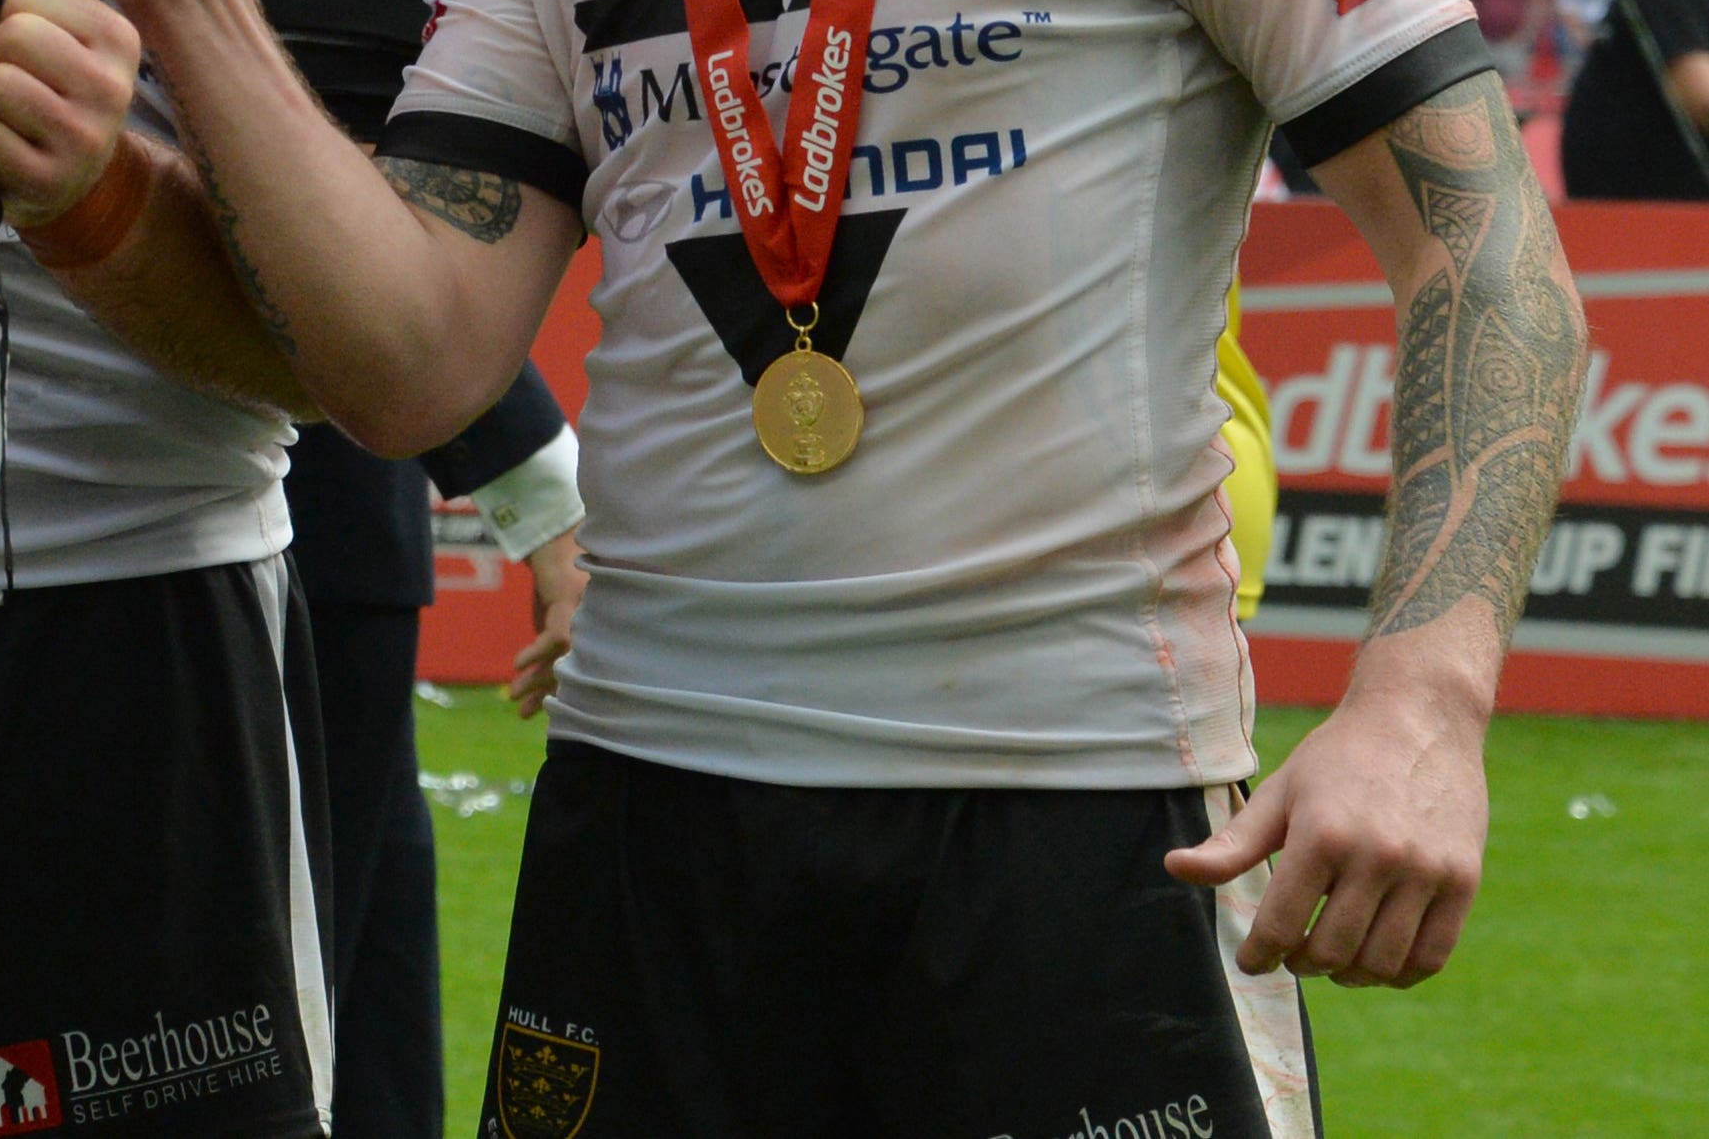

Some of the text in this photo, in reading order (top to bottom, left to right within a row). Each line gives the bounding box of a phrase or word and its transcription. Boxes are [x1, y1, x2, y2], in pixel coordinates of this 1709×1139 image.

[708, 49, 775, 219] Ladbrokes
[795, 26, 853, 214] Ladbrokes
[61, 1003, 275, 1094] Beerhouse
[508, 1005, 600, 1046] HULL F.C.
[72, 1054, 285, 1125] SELF DRIVE HIRE
